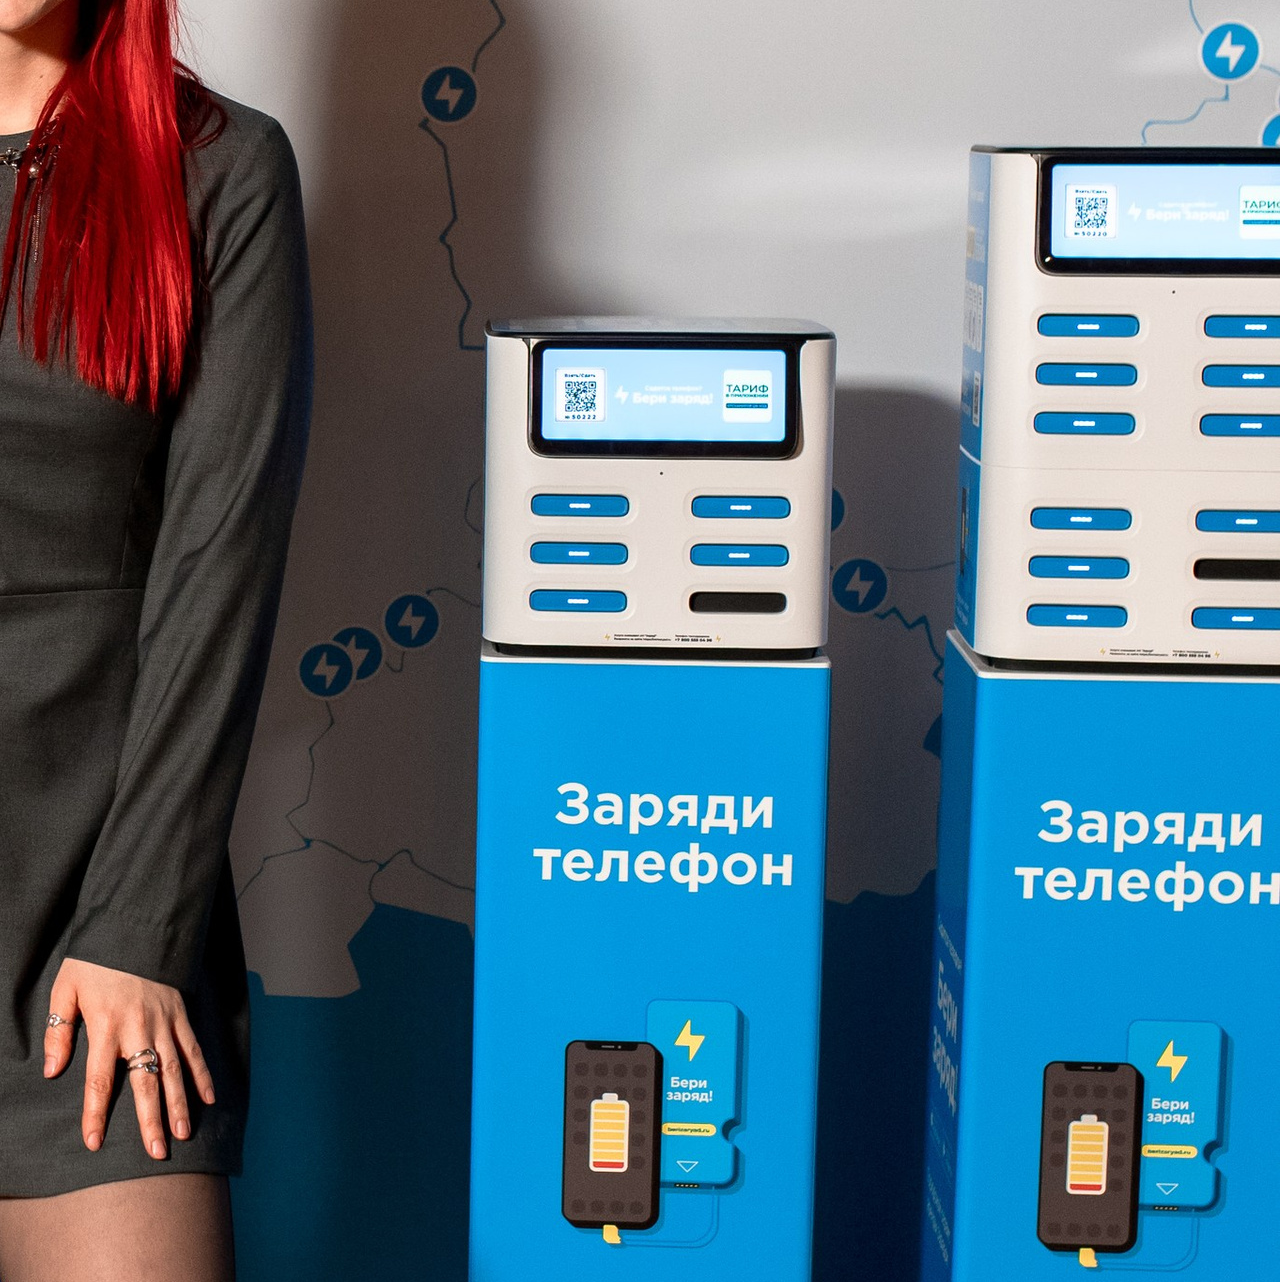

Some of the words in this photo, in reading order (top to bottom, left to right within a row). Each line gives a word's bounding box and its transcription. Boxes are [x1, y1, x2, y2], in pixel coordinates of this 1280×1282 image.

[726, 384, 768, 393] ТАРИФ
[632, 392, 668, 405] Бери
[670, 392, 713, 406] заряд!
[556, 782, 773, 834] Заряди
[1038, 800, 1262, 853] Заряди
[533, 843, 792, 892] телефон
[1015, 861, 1280, 911] телефон
[670, 1077, 708, 1089] Бери
[666, 1088, 713, 1103] заряд!
[1151, 1098, 1190, 1111] Бери
[1147, 1110, 1195, 1125] заряд!
